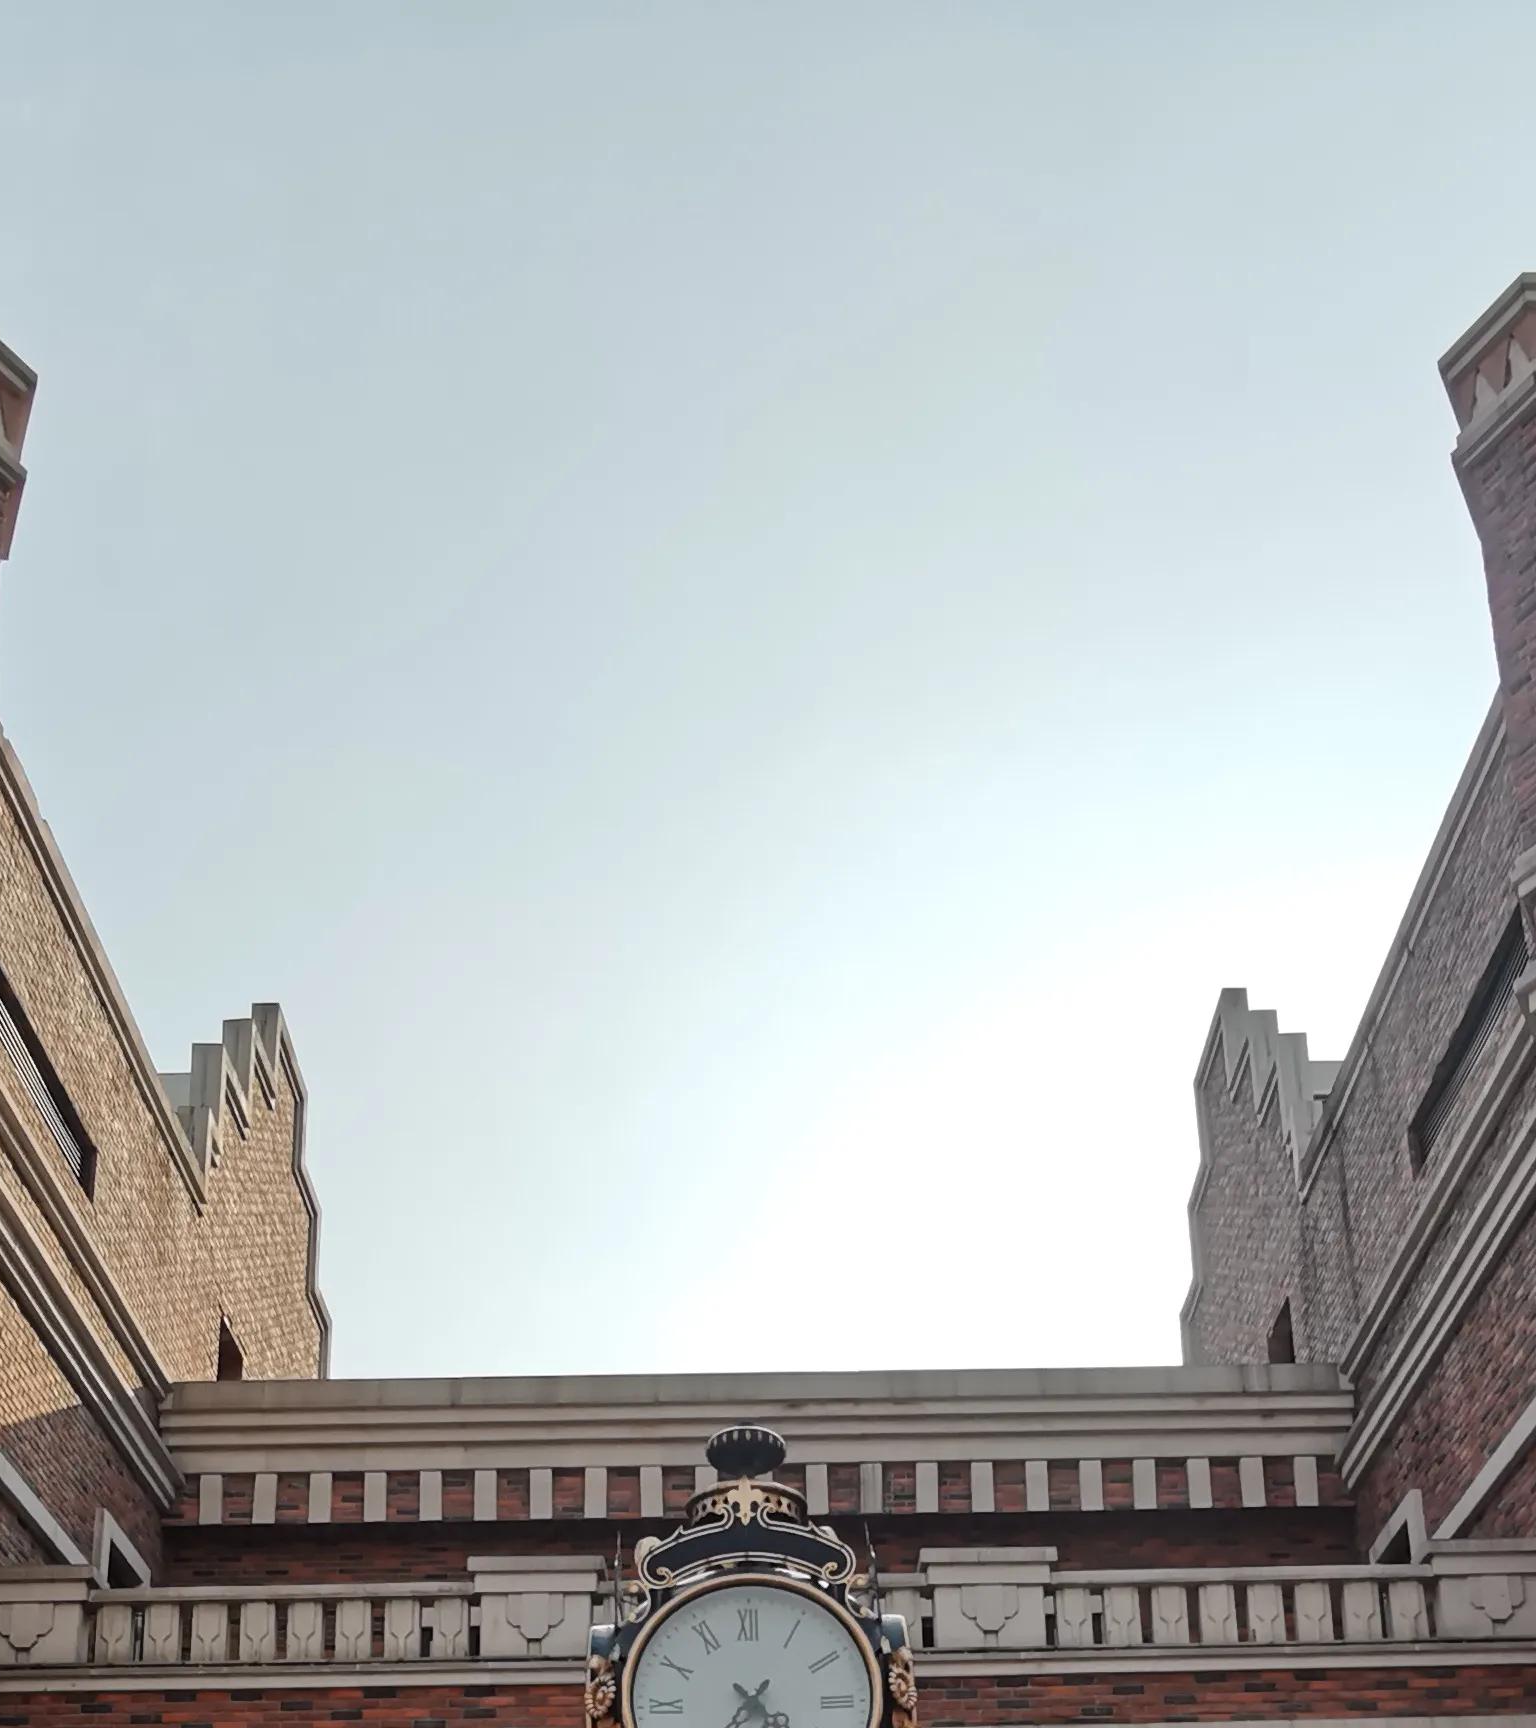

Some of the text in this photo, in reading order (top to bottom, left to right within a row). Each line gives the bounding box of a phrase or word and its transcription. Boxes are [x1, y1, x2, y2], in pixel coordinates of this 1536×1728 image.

[691, 1619, 721, 1655] XI
[737, 1608, 759, 1642] XII
[660, 1655, 694, 1680] X
[808, 1650, 839, 1674] II
[820, 1695, 854, 1710] III
